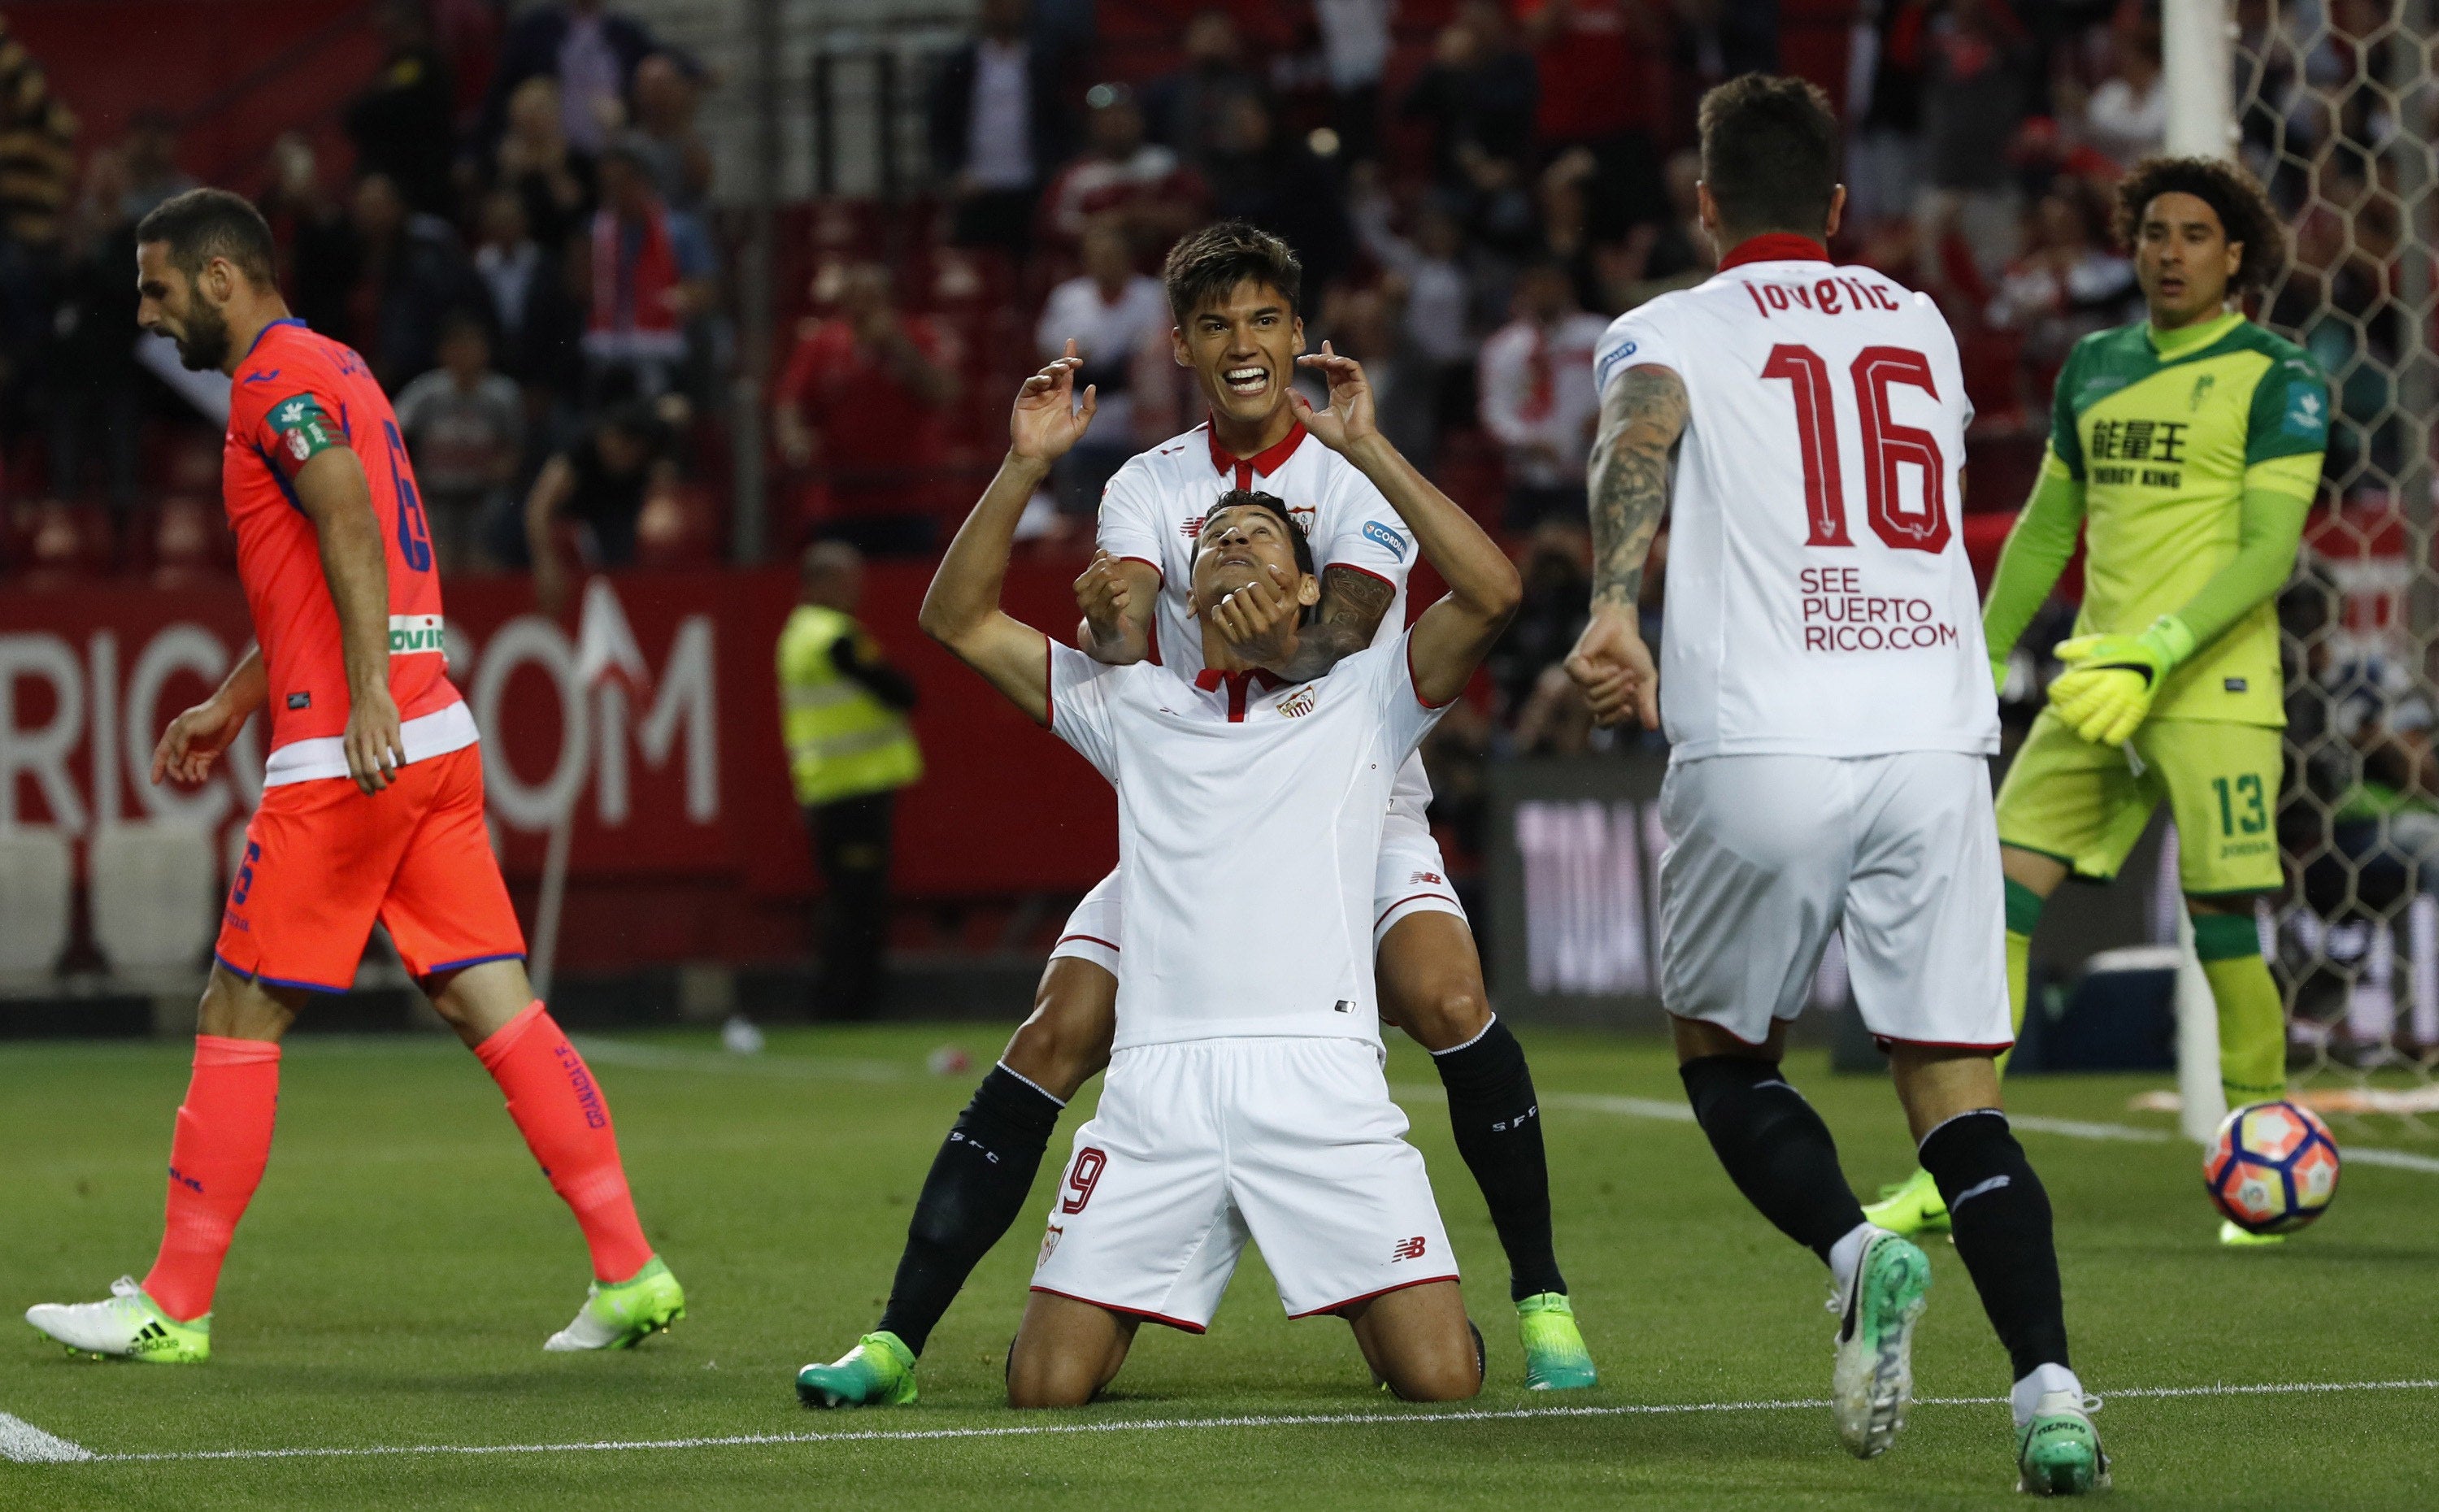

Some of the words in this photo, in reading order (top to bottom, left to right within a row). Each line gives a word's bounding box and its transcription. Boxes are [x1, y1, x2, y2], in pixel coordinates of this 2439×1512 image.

[1759, 343, 1952, 554] 16
[2093, 419, 2189, 464] 能量王
[2141, 469, 2180, 489] KING
[1800, 567, 1860, 594] SEE
[1803, 597, 1932, 623] PUERTO
[1805, 622, 1959, 651] RICO.COM
[2212, 774, 2267, 836] 13
